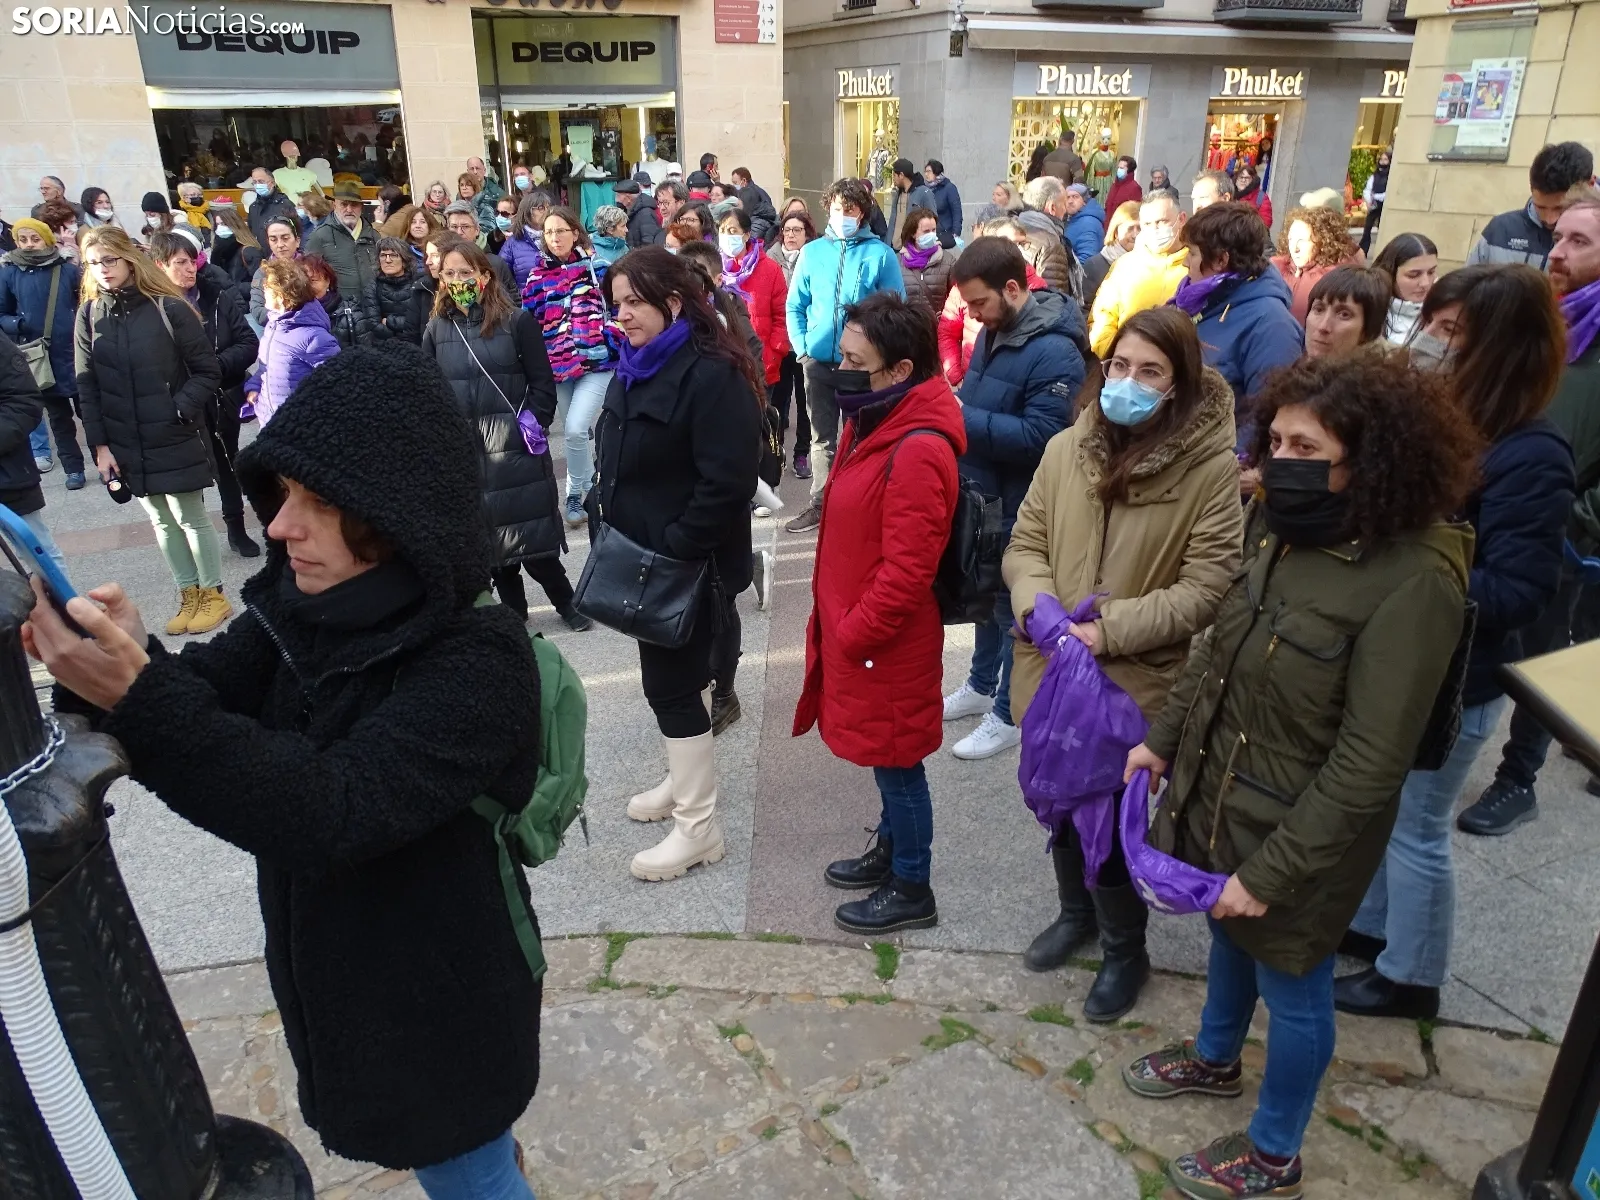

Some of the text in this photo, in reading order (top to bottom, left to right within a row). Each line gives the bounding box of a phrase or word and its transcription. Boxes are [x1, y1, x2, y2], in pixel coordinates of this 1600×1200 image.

[174, 26, 360, 55] DEQUIP
[511, 41, 656, 64] DEQUIP
[838, 69, 892, 97] Phuket
[1037, 65, 1132, 95] Phuket
[1221, 67, 1304, 96] Phuket
